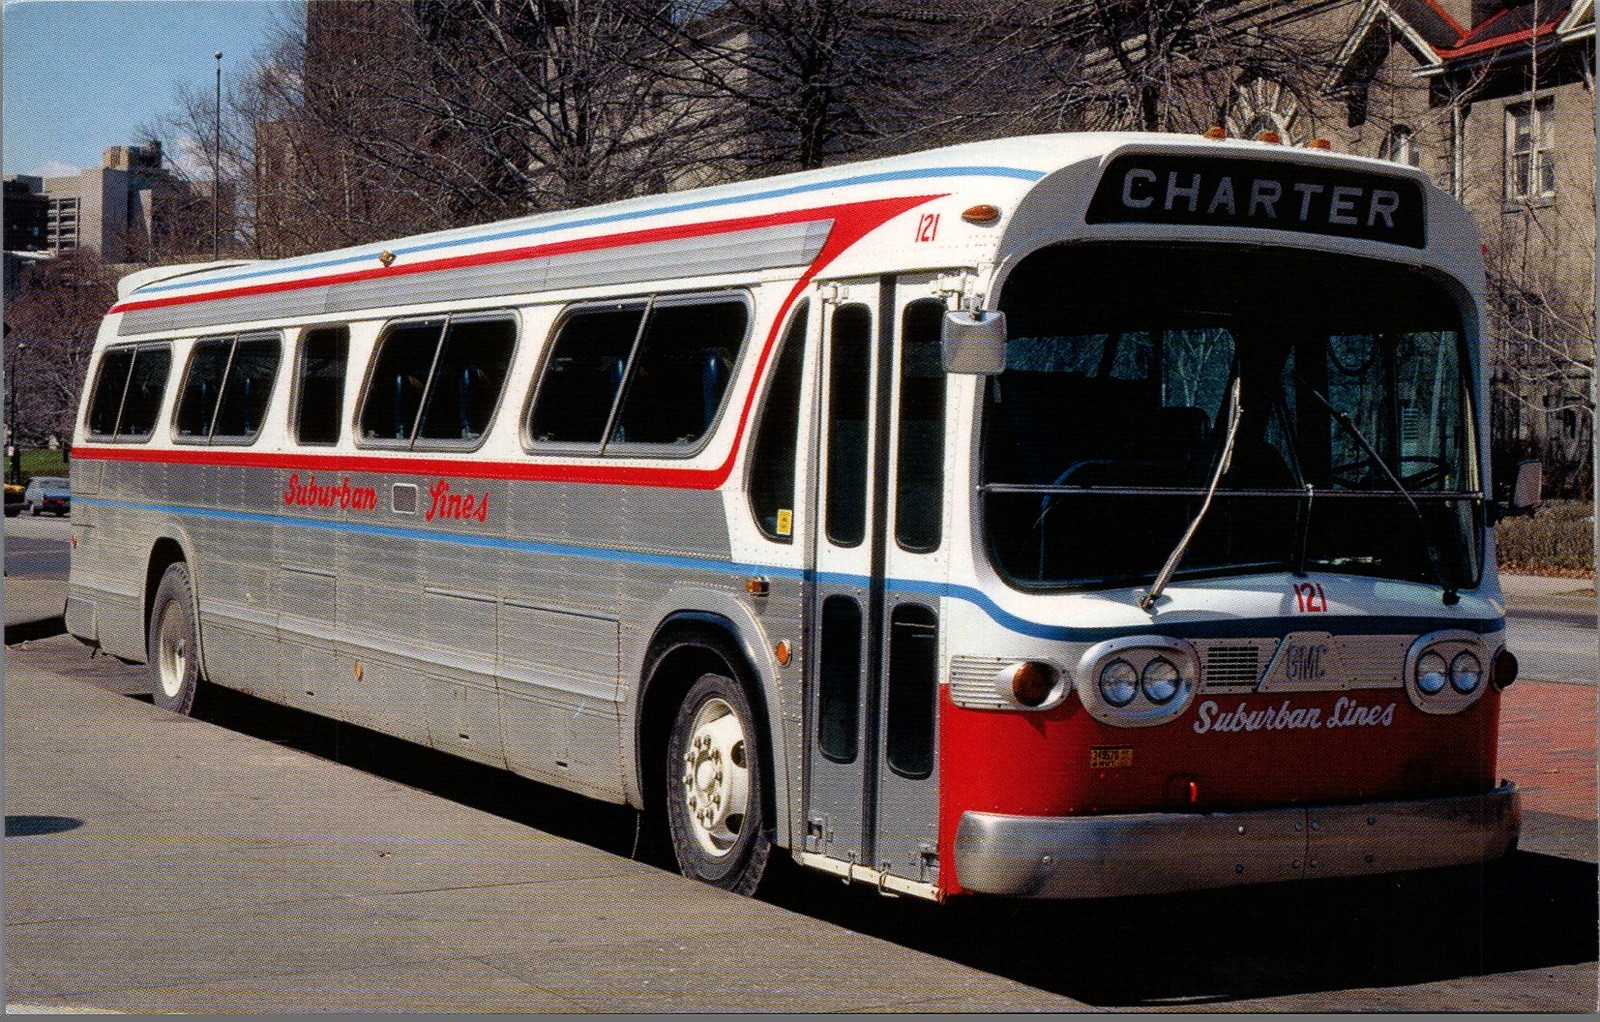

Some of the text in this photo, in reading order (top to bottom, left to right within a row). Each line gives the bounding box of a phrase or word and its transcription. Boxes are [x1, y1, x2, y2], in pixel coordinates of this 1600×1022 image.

[1121, 168, 1400, 228] CHARTER
[914, 213, 941, 243] 121
[283, 472, 490, 523] Suburban Lines
[1292, 582, 1328, 613] 121
[1284, 644, 1328, 681] GMC
[1193, 696, 1397, 734] Suburban Lines
